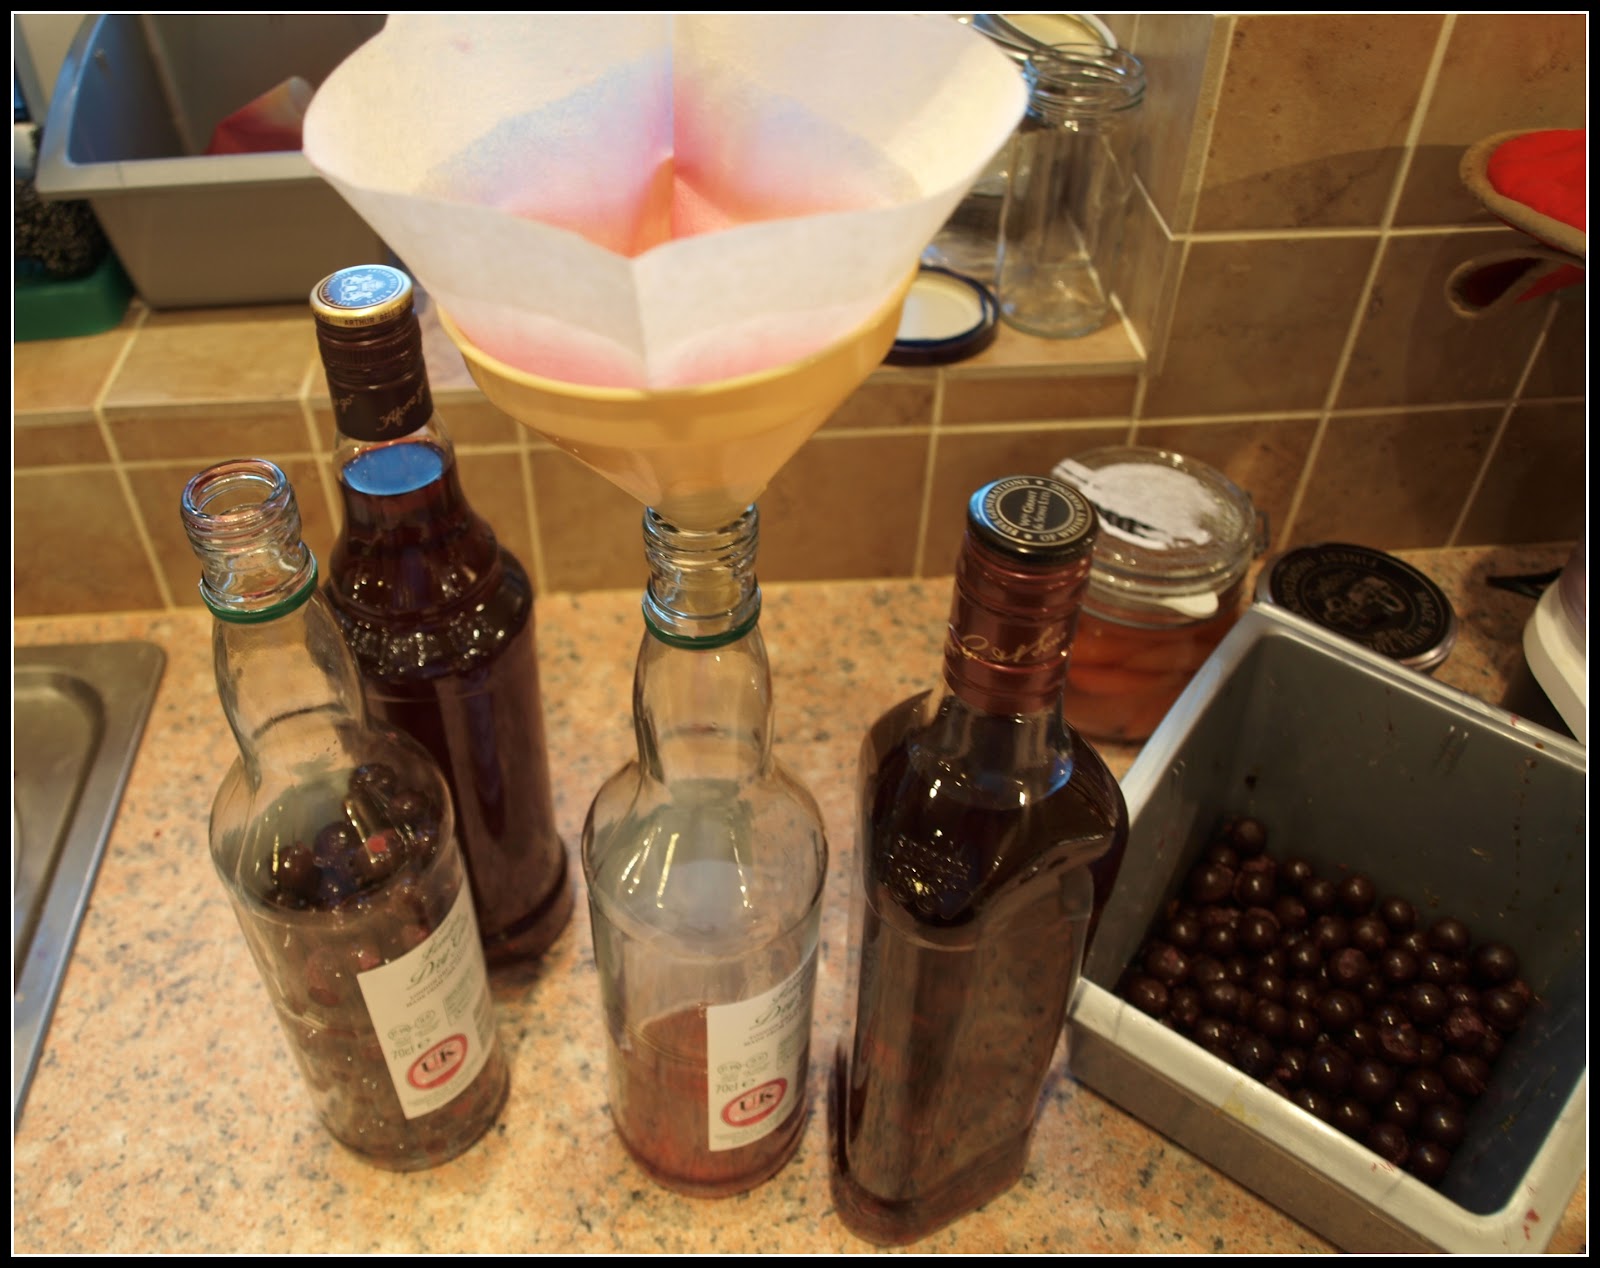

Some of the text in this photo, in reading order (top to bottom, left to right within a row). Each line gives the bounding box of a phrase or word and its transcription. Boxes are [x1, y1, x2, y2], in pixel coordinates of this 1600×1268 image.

[344, 317, 376, 327] ARTHUR
[985, 479, 1030, 520] GENERATIONS
[1039, 533, 1057, 542] OF
[1057, 511, 1087, 538] WHISKY
[421, 1048, 457, 1073] UK
[739, 1089, 775, 1112] UK
